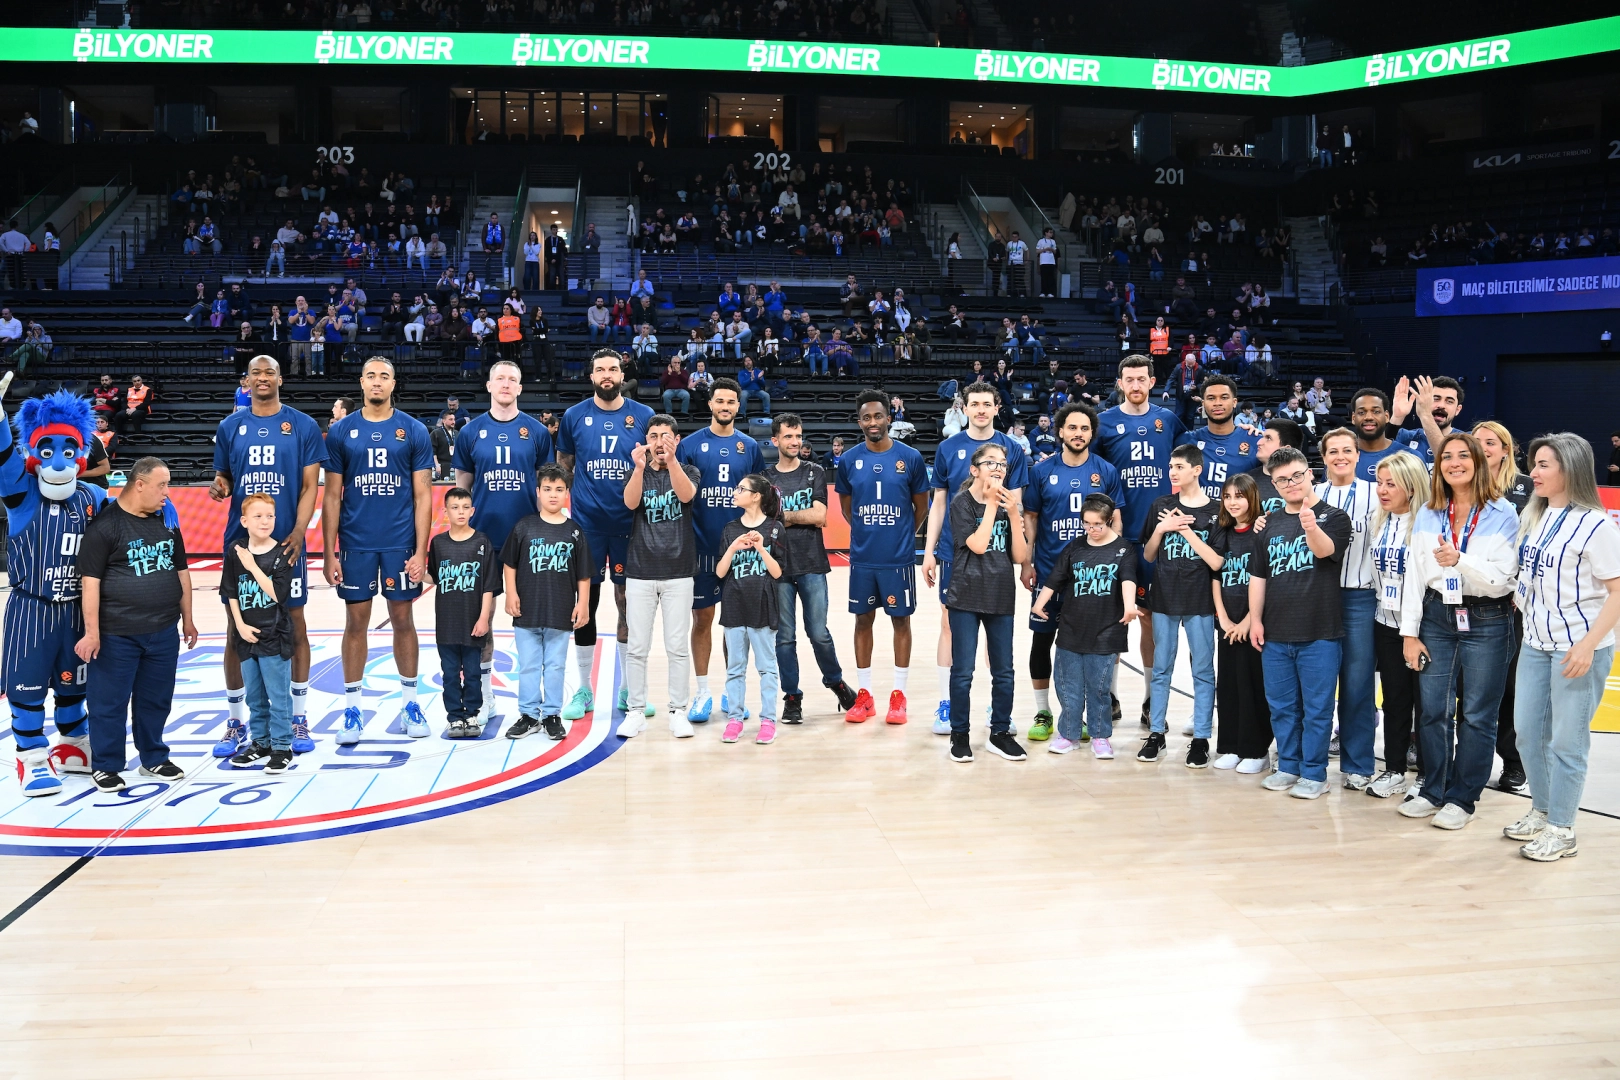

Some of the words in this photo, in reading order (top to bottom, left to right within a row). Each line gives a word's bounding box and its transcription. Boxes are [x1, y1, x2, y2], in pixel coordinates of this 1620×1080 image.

[754, 152, 791, 170] 202
[1527, 151, 1561, 161] SPORTAGE
[1154, 167, 1184, 186] 201
[1461, 282, 1485, 298] MAÇ
[1487, 276, 1555, 295] BİLETLERİMİZ
[1557, 275, 1599, 291] SADECE
[601, 435, 619, 453] 17
[1130, 441, 1154, 460] 24
[249, 445, 275, 465] 88
[367, 448, 387, 467] 13
[495, 446, 510, 464] 11
[587, 459, 630, 472] ANADOLU
[718, 464, 730, 482] 8
[1121, 466, 1163, 480] ANADOLU
[1207, 462, 1228, 482] 15
[240, 472, 285, 487] ANADOLU
[354, 473, 401, 487] ANADOLU
[484, 469, 526, 483] ANADOLU
[594, 470, 625, 480] EFES
[1127, 477, 1159, 488] EFES
[245, 484, 280, 495] EFES
[362, 485, 395, 496] EFES
[489, 481, 521, 491] EFES
[701, 486, 735, 499] ANADO
[876, 481, 882, 500] 1
[643, 489, 676, 508] POWE
[645, 504, 683, 524] TEAM
[858, 504, 901, 518] ANADOLU
[863, 515, 895, 526] EFES
[1052, 517, 1084, 532] ANAD
[530, 538, 545, 546] THE
[1059, 529, 1087, 540] EFE
[529, 541, 574, 561] POWER
[1267, 534, 1307, 562] POWE
[438, 561, 480, 581] POWER
[529, 555, 569, 574] TEAM
[1073, 563, 1119, 581] POWER
[1269, 549, 1314, 577] TEAM
[439, 575, 475, 595] TEAM
[1074, 578, 1112, 597] TEAM
[1385, 585, 1396, 599] 171
[1445, 578, 1458, 591] 181
[904, 589, 910, 607] 1
